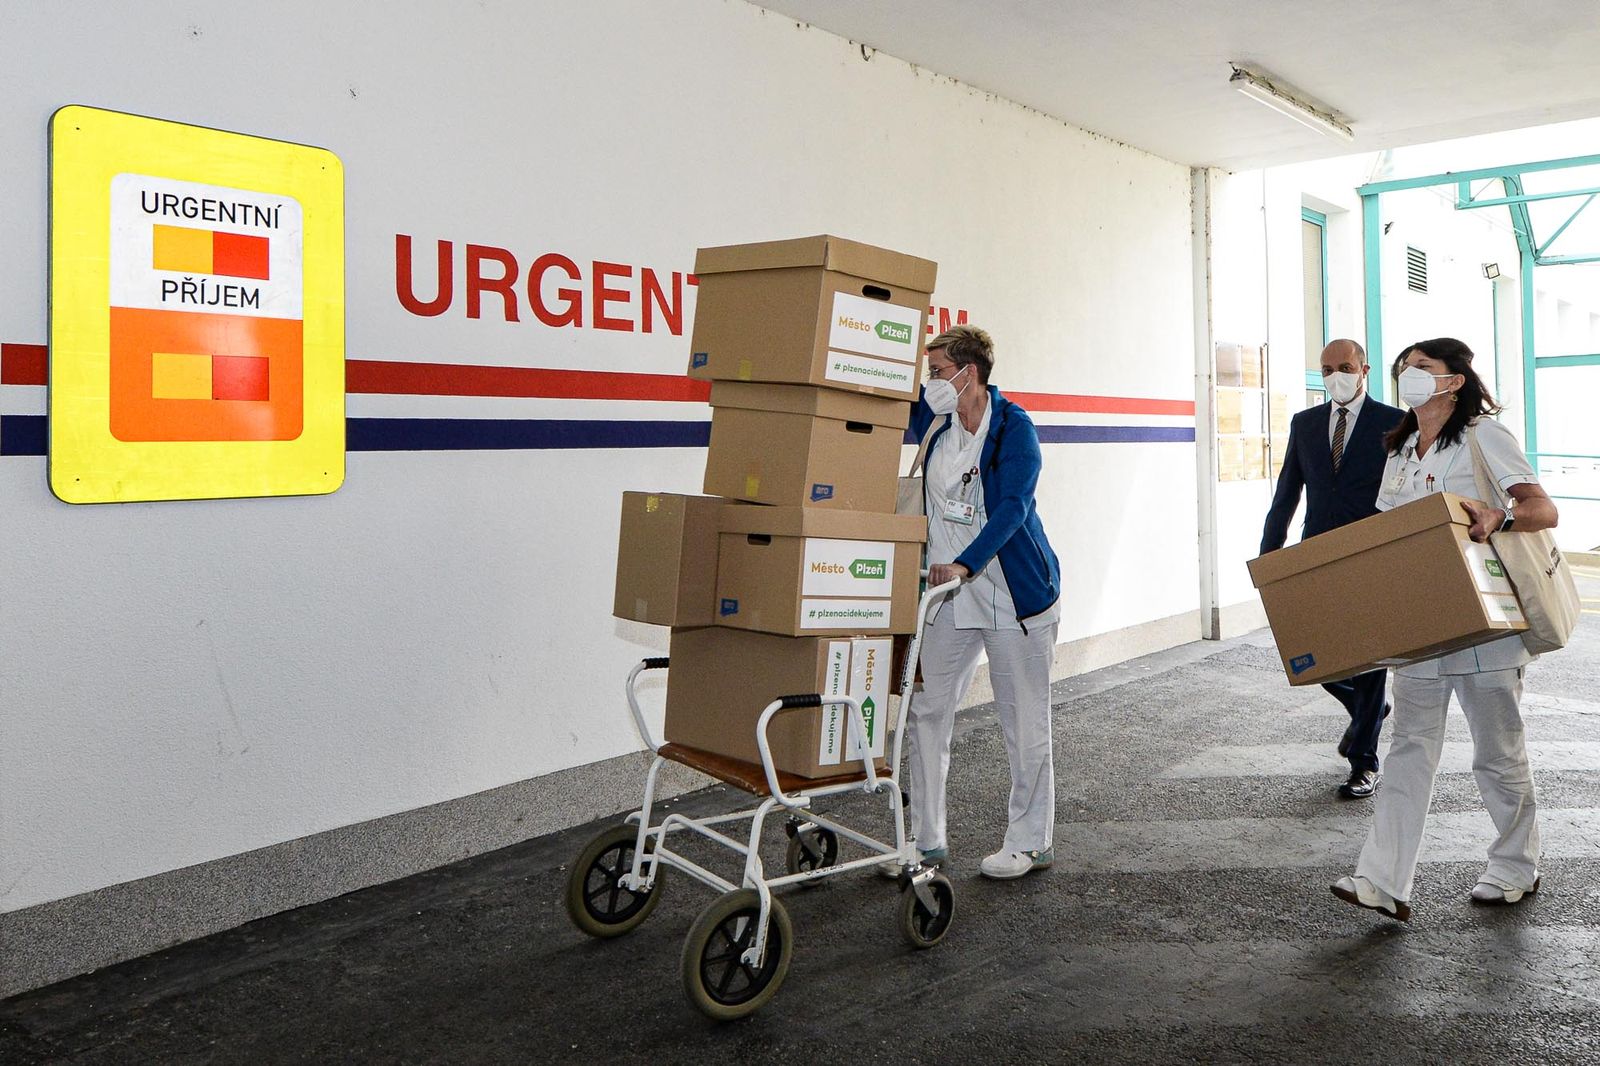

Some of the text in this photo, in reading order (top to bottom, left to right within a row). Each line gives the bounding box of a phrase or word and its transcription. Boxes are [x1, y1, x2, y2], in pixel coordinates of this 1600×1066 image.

[141, 190, 283, 229] URGENTNÍ
[161, 277, 260, 309] PŘÍJEM
[838, 316, 909, 340] Město Plzeň
[811, 562, 883, 575] Město Plzeň
